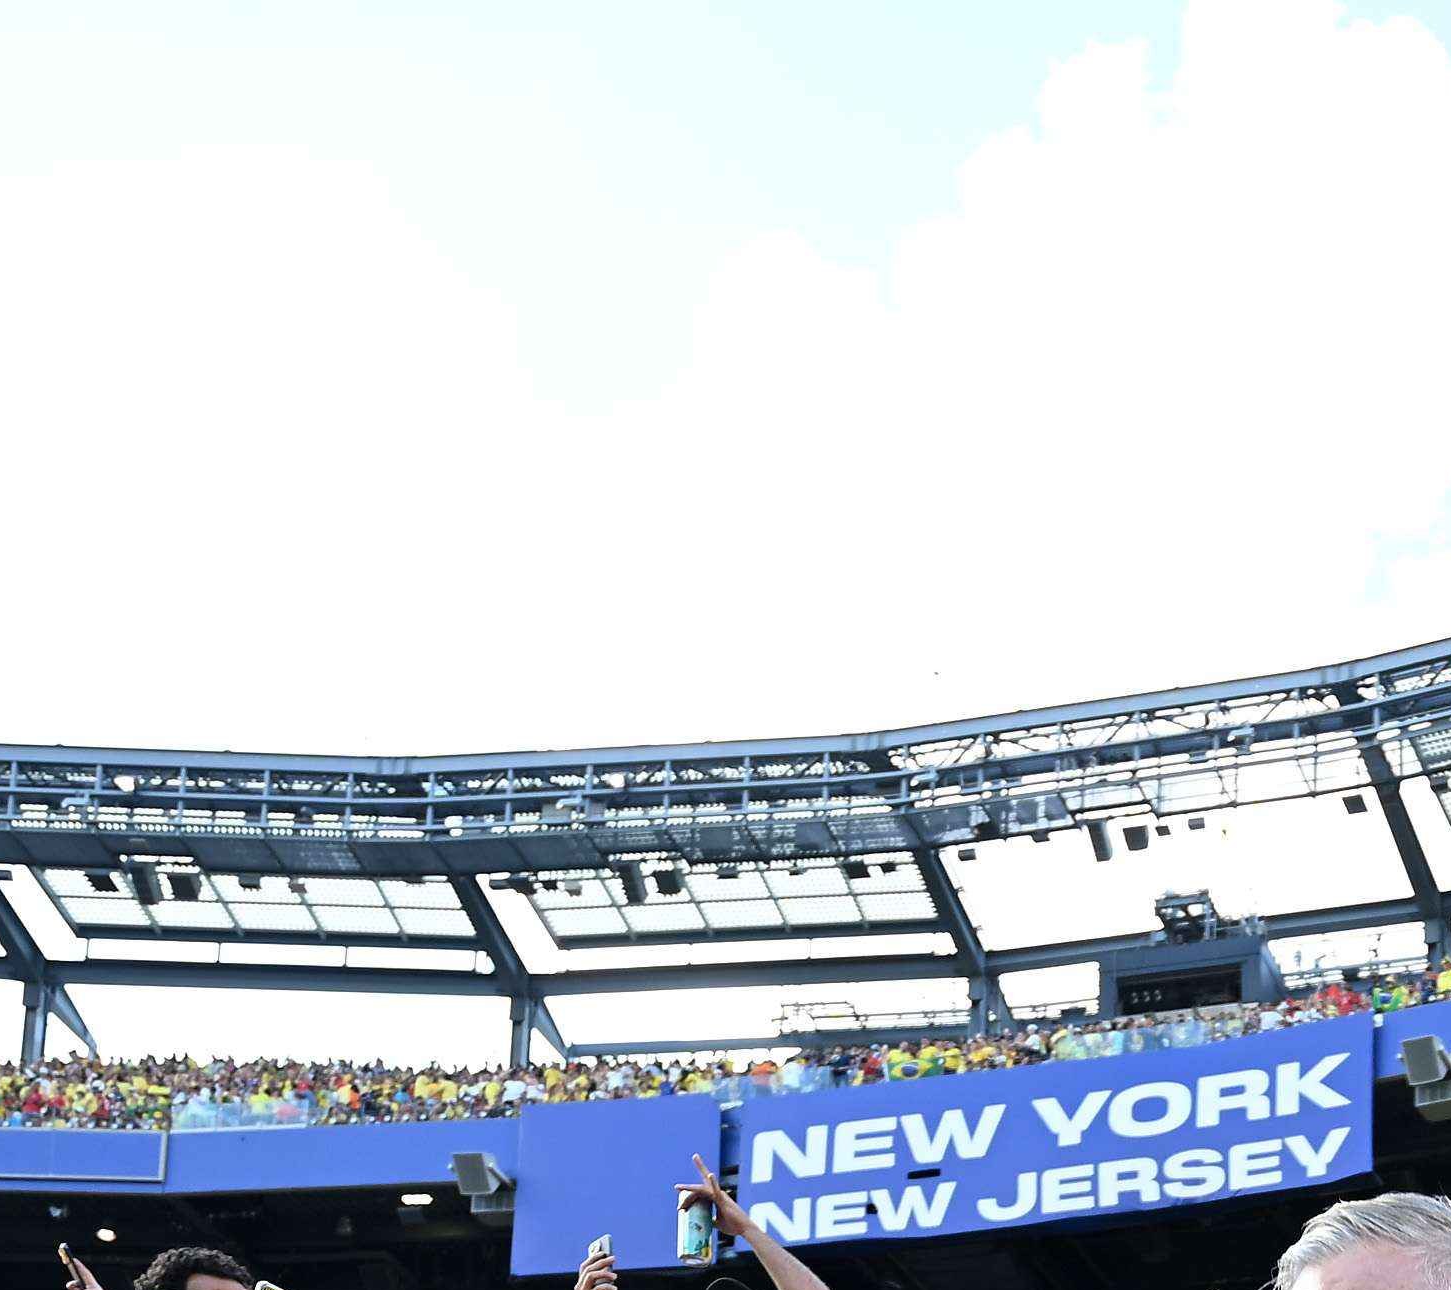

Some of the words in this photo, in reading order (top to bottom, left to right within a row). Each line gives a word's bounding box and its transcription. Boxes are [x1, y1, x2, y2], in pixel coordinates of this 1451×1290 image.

[751, 1102, 1007, 1184] NEW
[1033, 1052, 1352, 1147] YORK
[749, 1181, 957, 1242] NEW
[976, 1125, 1351, 1222] JERSEY
